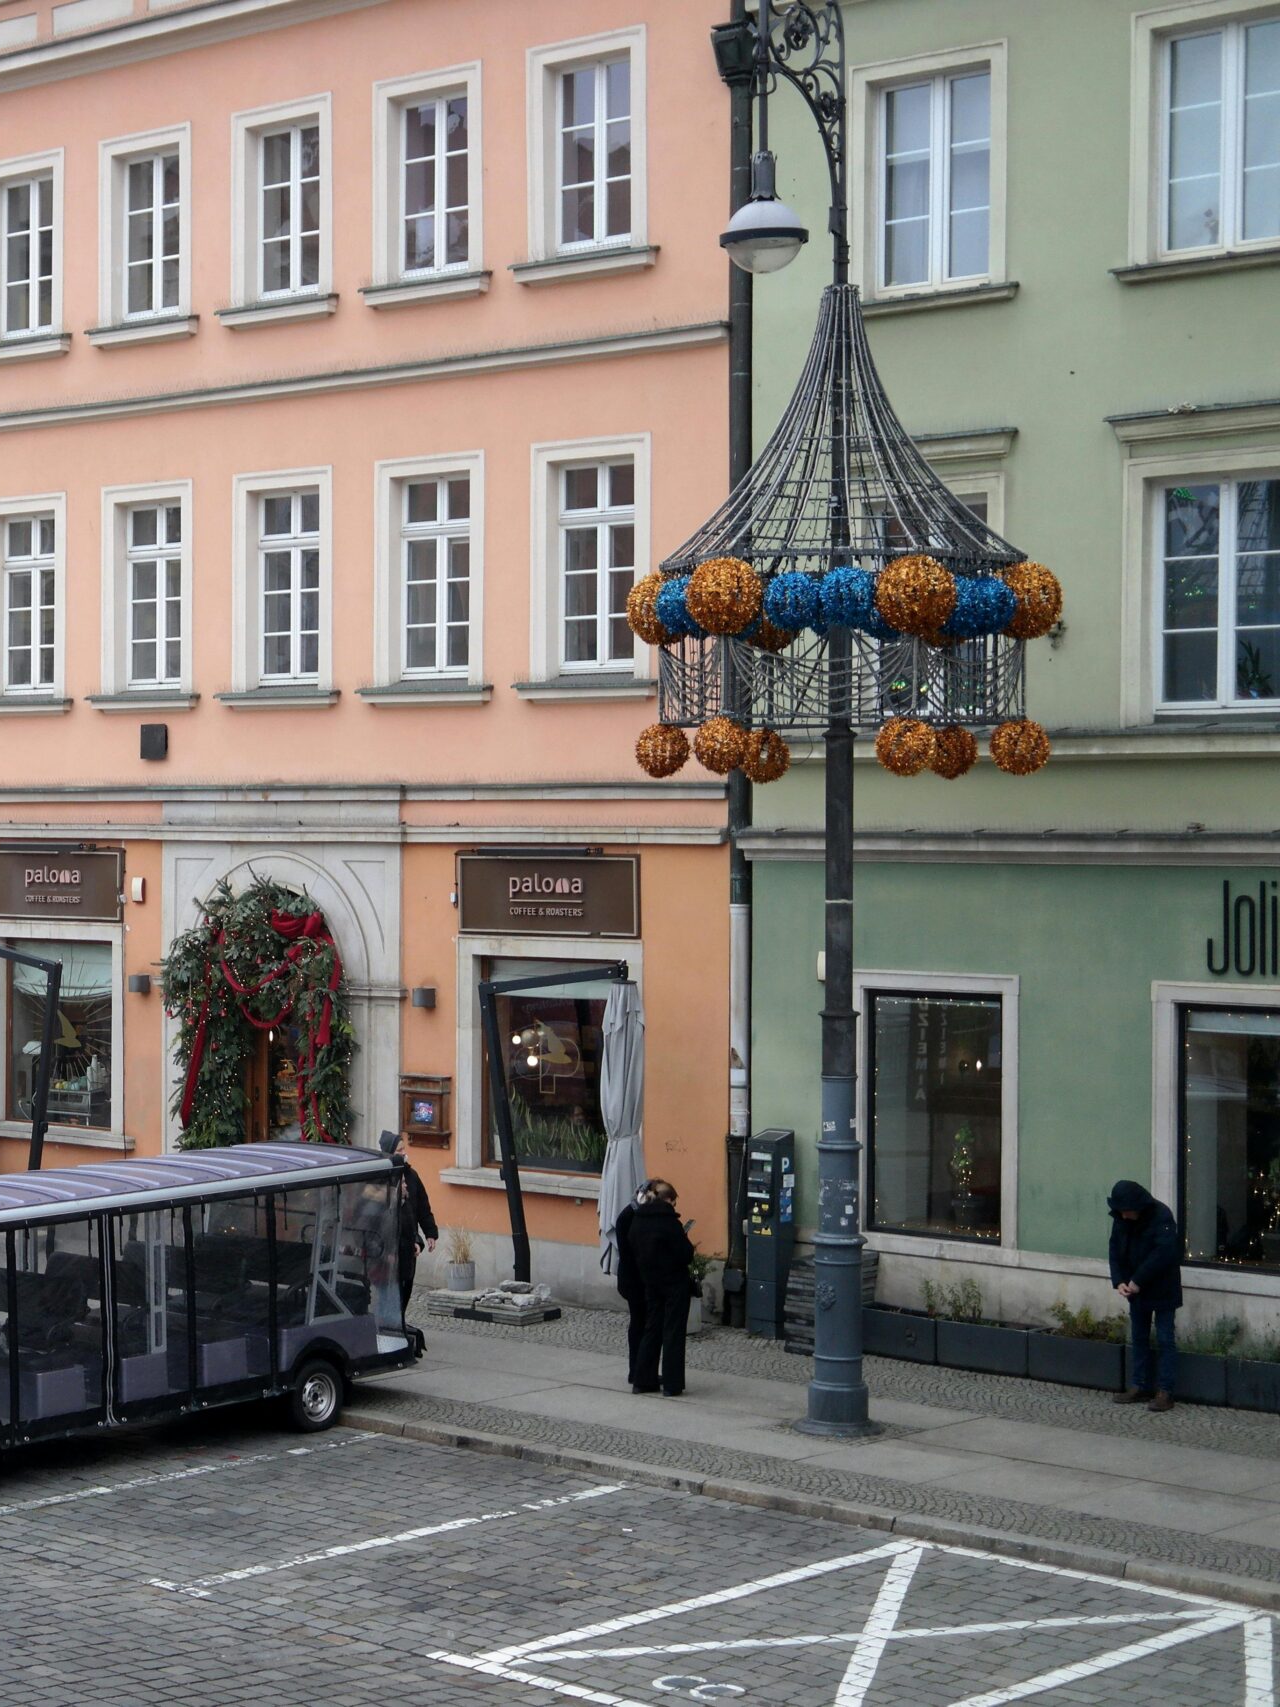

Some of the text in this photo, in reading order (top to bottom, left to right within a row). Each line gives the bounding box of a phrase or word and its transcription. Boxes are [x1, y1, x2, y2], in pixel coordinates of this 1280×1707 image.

[25, 865, 81, 888] paloma
[509, 873, 582, 898] paloma
[25, 894, 81, 904] COFFEE & ROASTERS
[509, 907, 583, 917] COFFEE & ROASTERS
[781, 1157, 790, 1172] P
